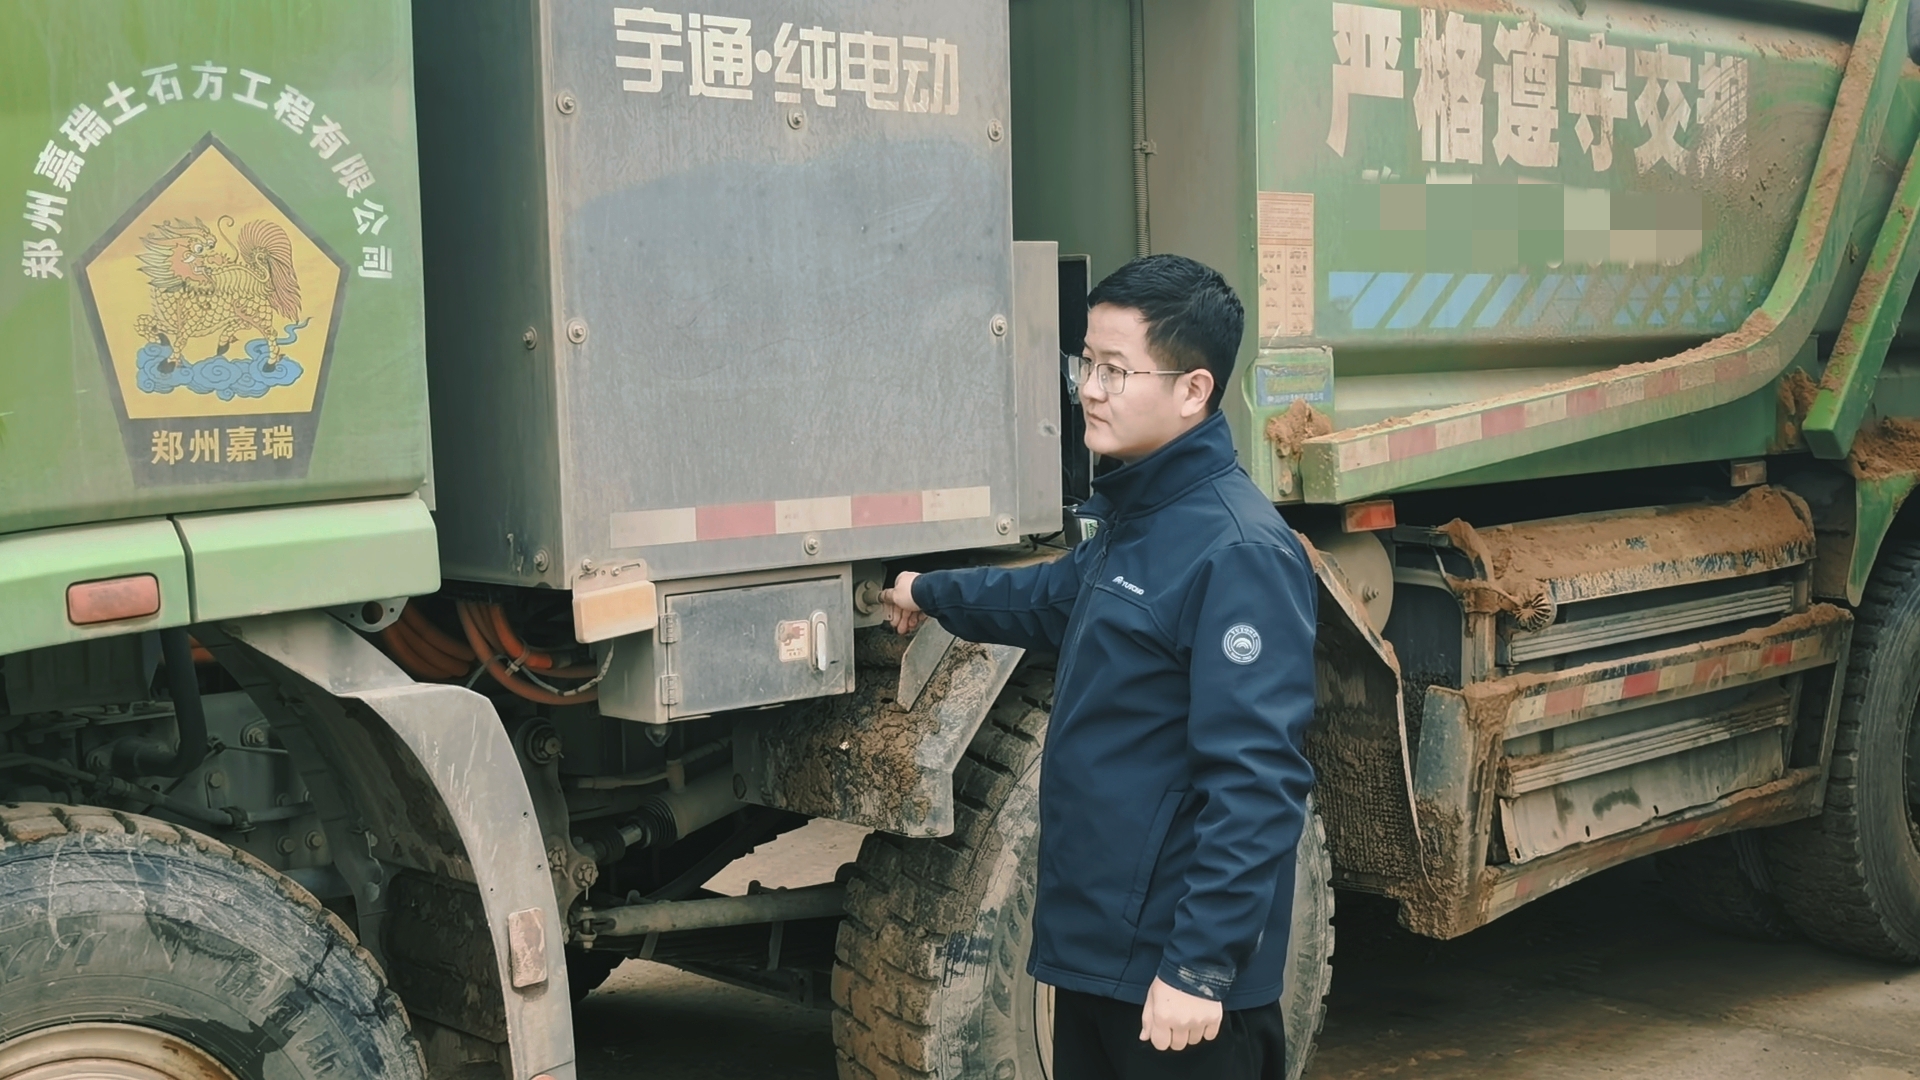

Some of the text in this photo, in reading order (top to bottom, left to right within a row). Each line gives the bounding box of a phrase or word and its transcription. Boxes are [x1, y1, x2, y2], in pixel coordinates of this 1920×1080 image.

[22, 61, 392, 279] 郑州嘉瑞土石方工程有限公司
[151, 424, 294, 465] 郑州嘉瑞
